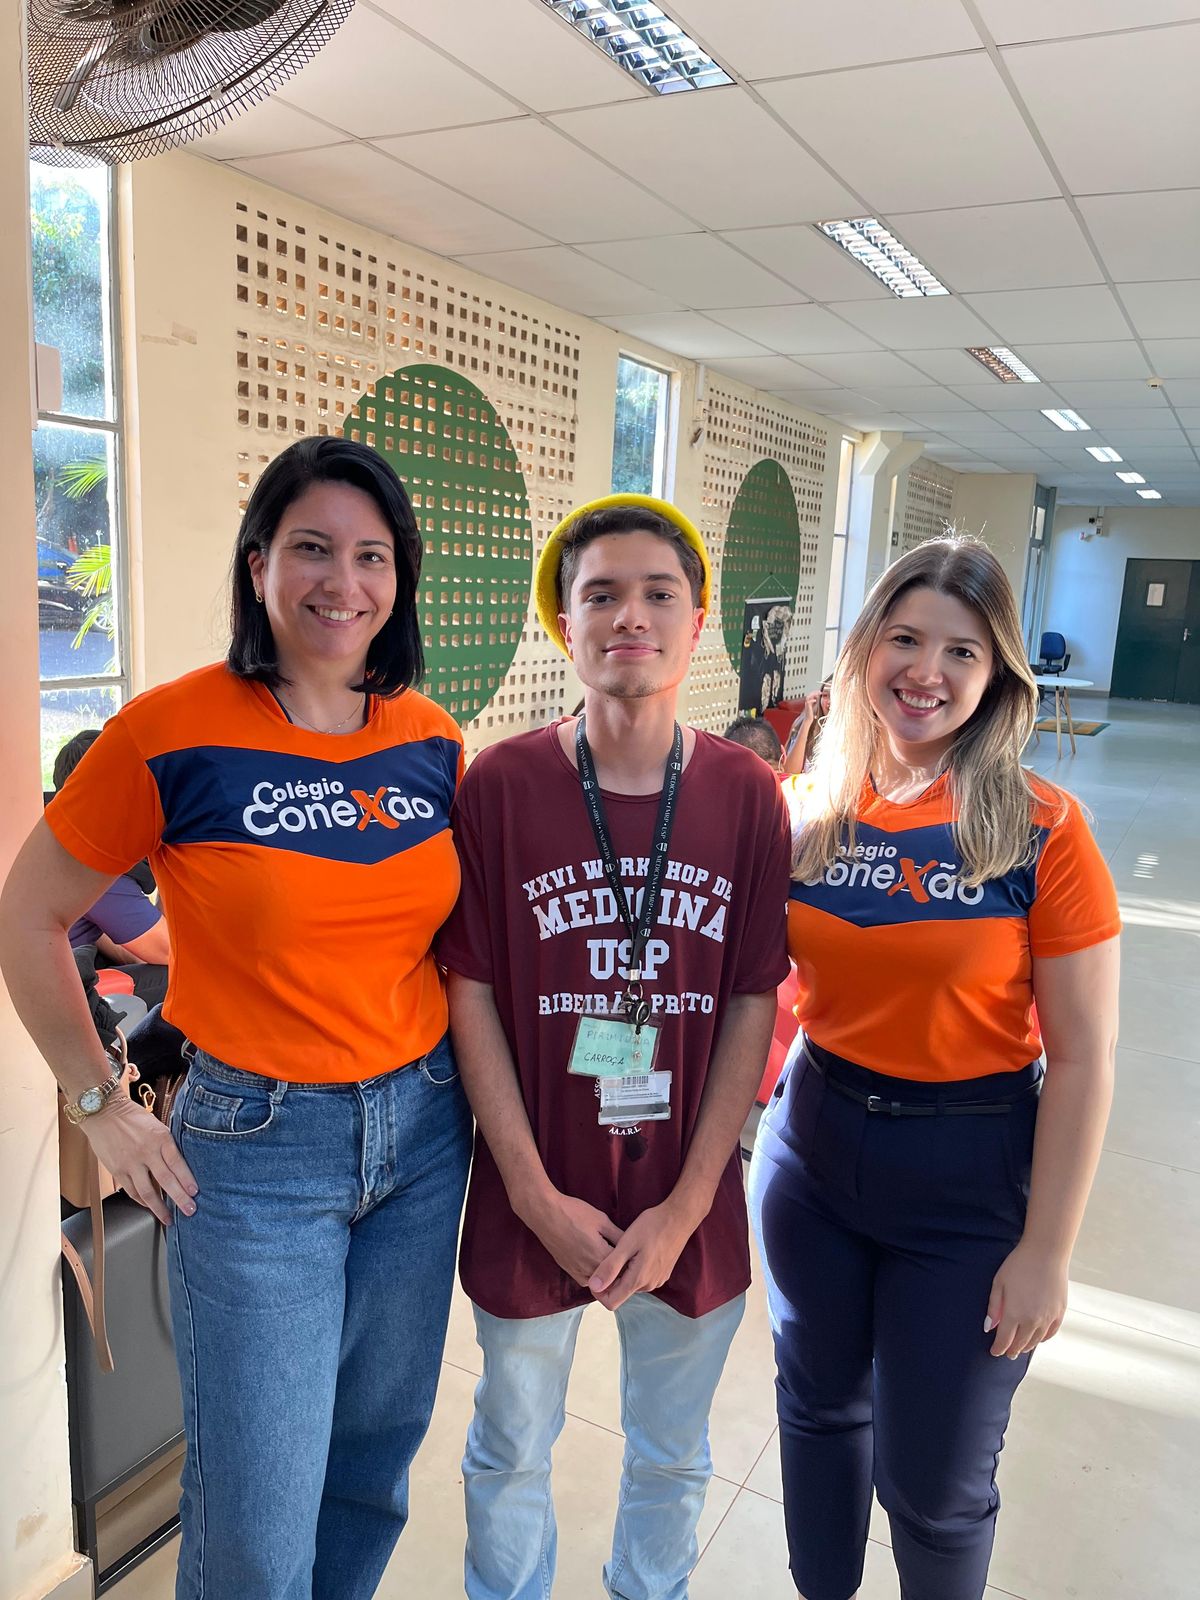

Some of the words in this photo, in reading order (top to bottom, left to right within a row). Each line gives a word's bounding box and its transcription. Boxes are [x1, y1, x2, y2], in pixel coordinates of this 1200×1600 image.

[252, 777, 344, 808] Colégio
[667, 773, 677, 804] MEDICINA
[660, 826, 668, 839] USP
[836, 842, 898, 862] olégio
[521, 865, 577, 901] XXVI
[581, 857, 709, 887] WRKHOP
[653, 855, 663, 886] MEDICINA
